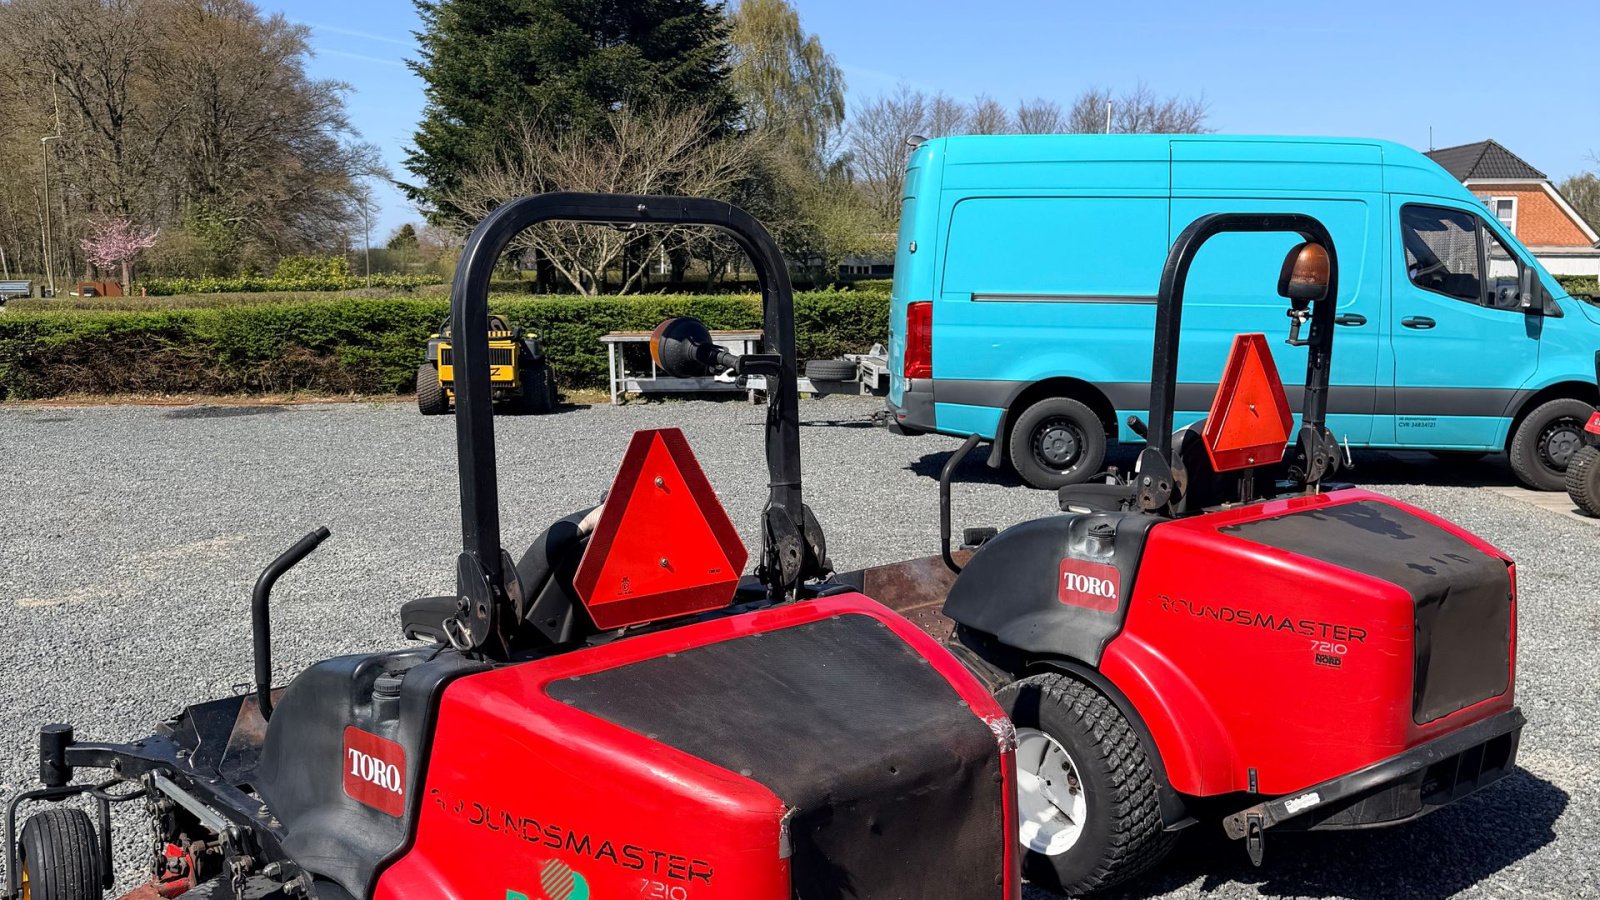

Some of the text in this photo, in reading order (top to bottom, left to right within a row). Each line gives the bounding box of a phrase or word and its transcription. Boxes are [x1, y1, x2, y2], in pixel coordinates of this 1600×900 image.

[1157, 595, 1368, 643] ROUNDSMASTER
[1311, 640, 1348, 655] 7210
[431, 788, 714, 885] OUNDSMASTER
